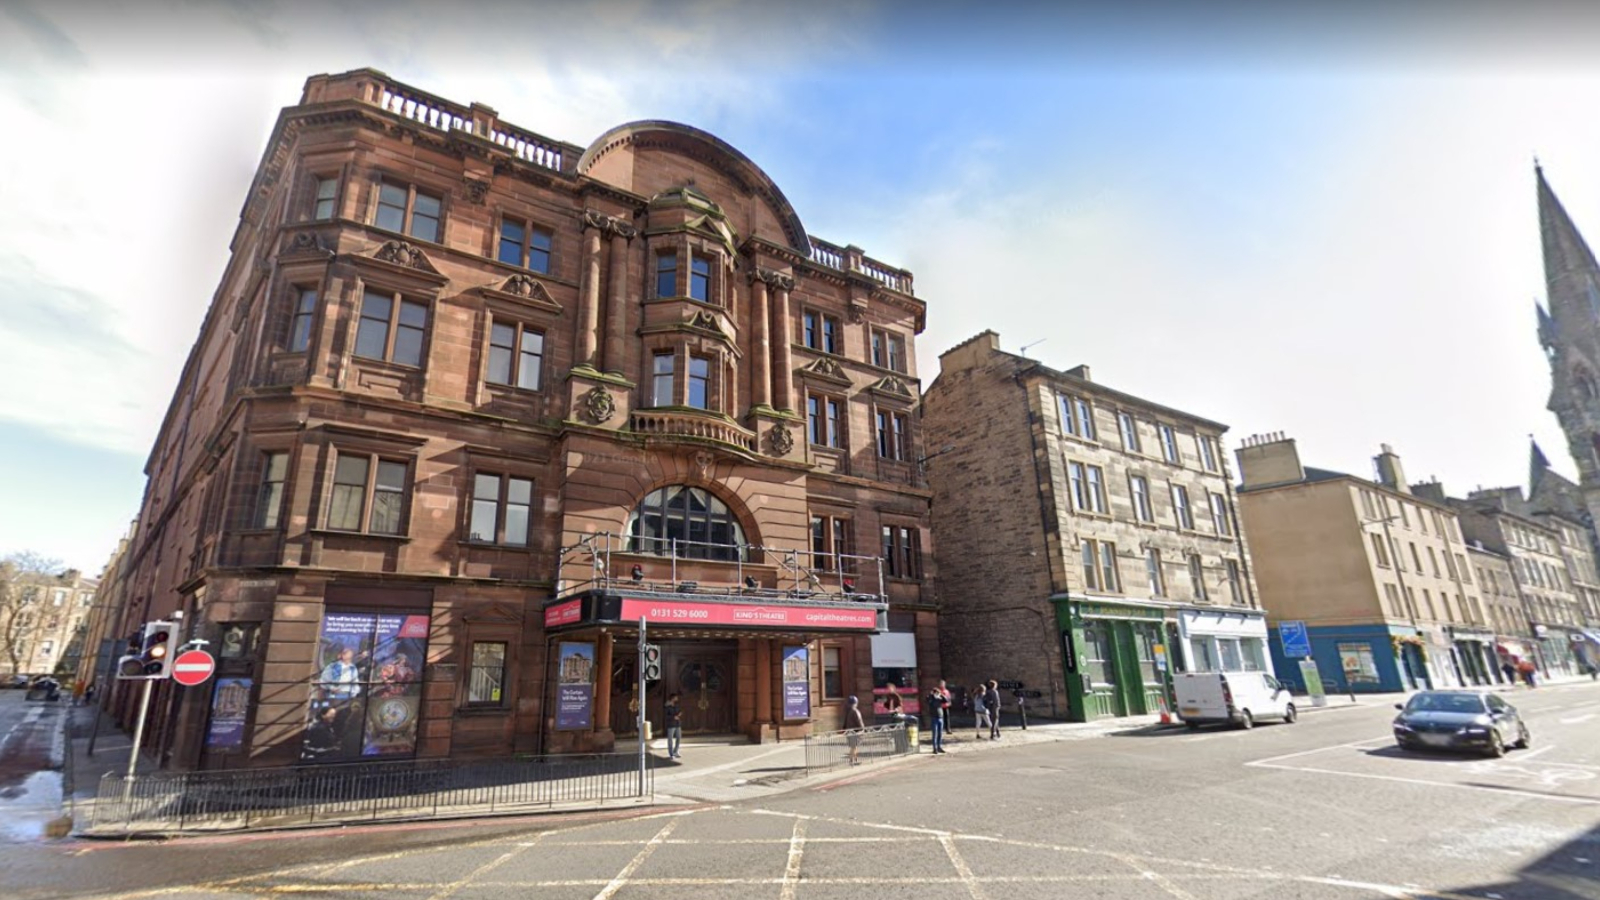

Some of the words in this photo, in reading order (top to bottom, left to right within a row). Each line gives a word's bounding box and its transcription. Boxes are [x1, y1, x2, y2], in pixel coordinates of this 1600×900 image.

[651, 609, 671, 618] 0131
[672, 610, 688, 618] 529
[689, 610, 708, 619] 6000
[806, 613, 872, 623] capitaltheatres.com
